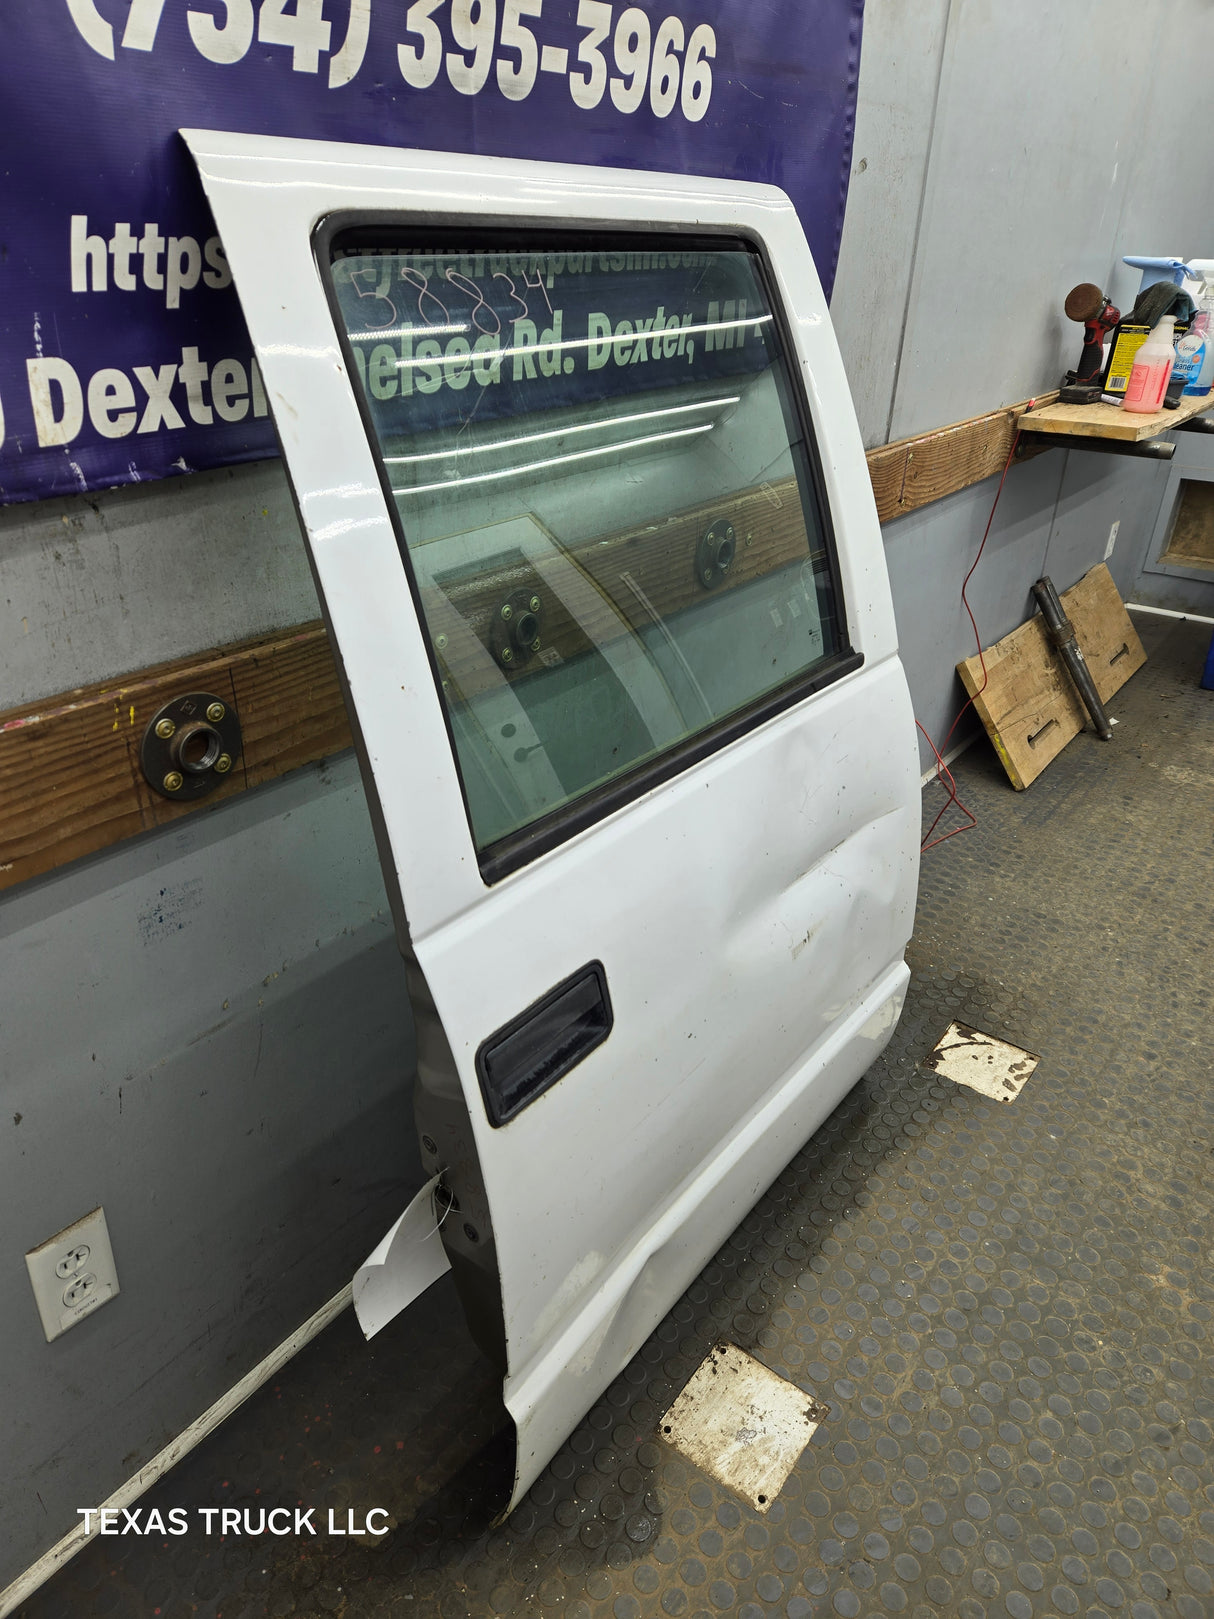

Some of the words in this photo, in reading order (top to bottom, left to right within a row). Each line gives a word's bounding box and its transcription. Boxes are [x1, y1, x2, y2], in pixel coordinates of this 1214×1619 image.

[397, 0, 717, 122] 395-3966
[71, 215, 234, 309] https
[351, 268, 553, 336] 58834
[513, 310, 576, 380] Rd.
[588, 306, 695, 369] Dexter,
[705, 299, 747, 352] MI
